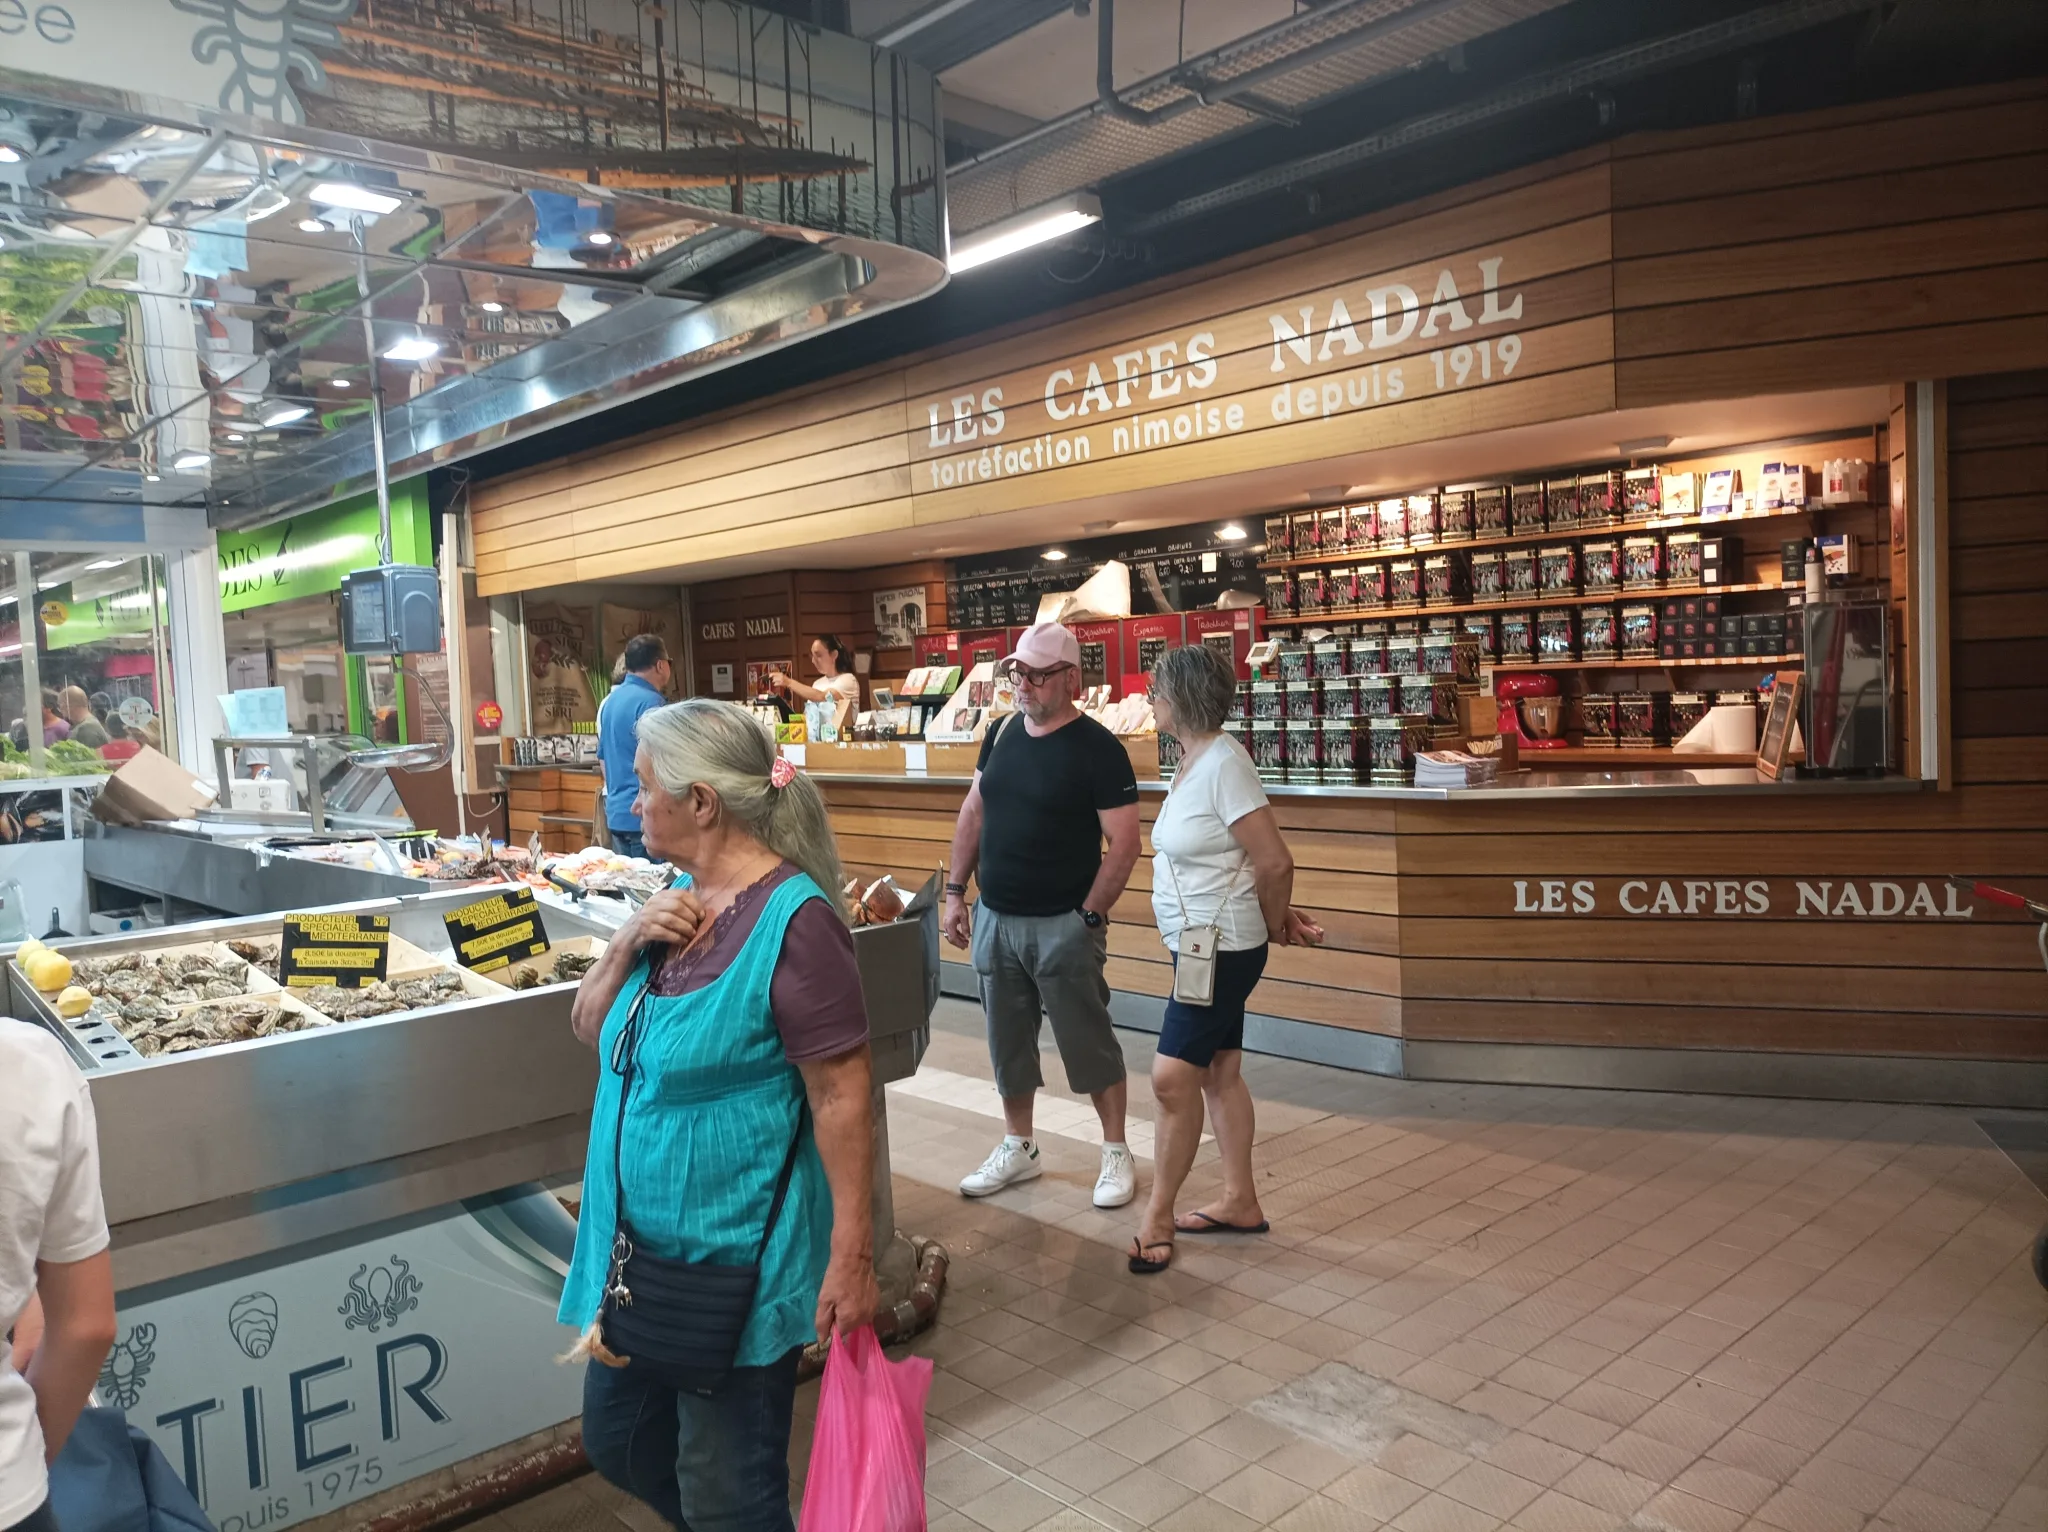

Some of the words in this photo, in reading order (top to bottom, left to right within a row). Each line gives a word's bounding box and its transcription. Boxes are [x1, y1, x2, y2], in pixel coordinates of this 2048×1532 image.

[927, 387, 1006, 448] LES
[1044, 332, 1218, 421] CAFES
[1268, 256, 1523, 372] NADAL
[930, 431, 1090, 488] torréfaction
[1112, 402, 1244, 453] nimoise
[1271, 363, 1405, 422] depuis
[1430, 334, 1522, 389] 1919
[702, 622, 736, 640] CAFES
[746, 617, 784, 636] NADAL
[444, 896, 504, 920] PRODUCTEUR
[1513, 881, 1595, 914] LES
[1618, 881, 1770, 914] CAFES
[1795, 881, 1974, 917] NADAL
[285, 913, 355, 923] PRODUCTEUR
[302, 922, 358, 932] SPECIALES
[461, 903, 509, 925] SPECIALES
[473, 902, 538, 930] MEDITERRANEE
[311, 931, 389, 941] MEDITERRANEE
[155, 1332, 451, 1511] TIER
[303, 1456, 384, 1508] 1975
